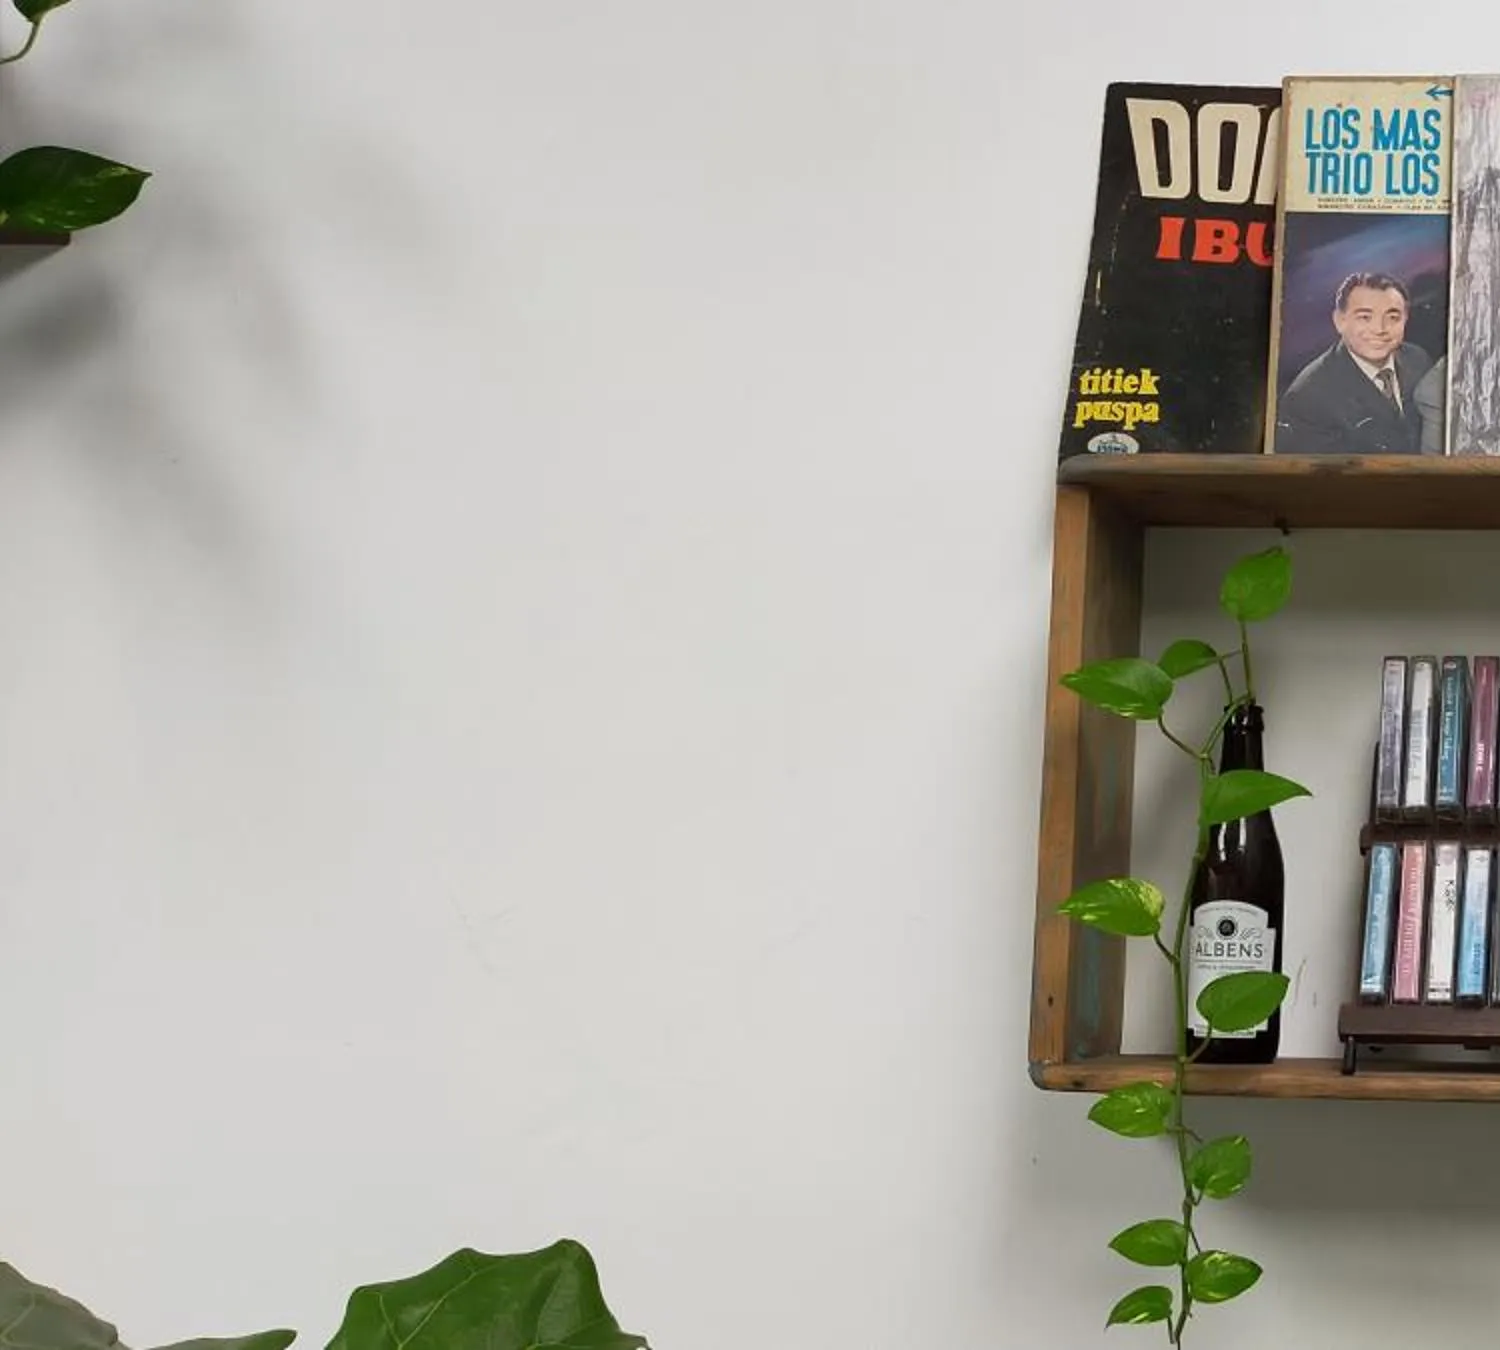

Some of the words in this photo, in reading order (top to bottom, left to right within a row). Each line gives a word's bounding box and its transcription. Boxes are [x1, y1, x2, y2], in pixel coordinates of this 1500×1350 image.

[1305, 107, 1361, 151] LOS
[1372, 108, 1441, 151] MAS
[1305, 152, 1373, 195] TRIO
[1385, 153, 1441, 196] LOS
[1080, 367, 1161, 395] titiek
[1072, 400, 1161, 431] puspa
[1195, 941, 1264, 959] ALBENS
